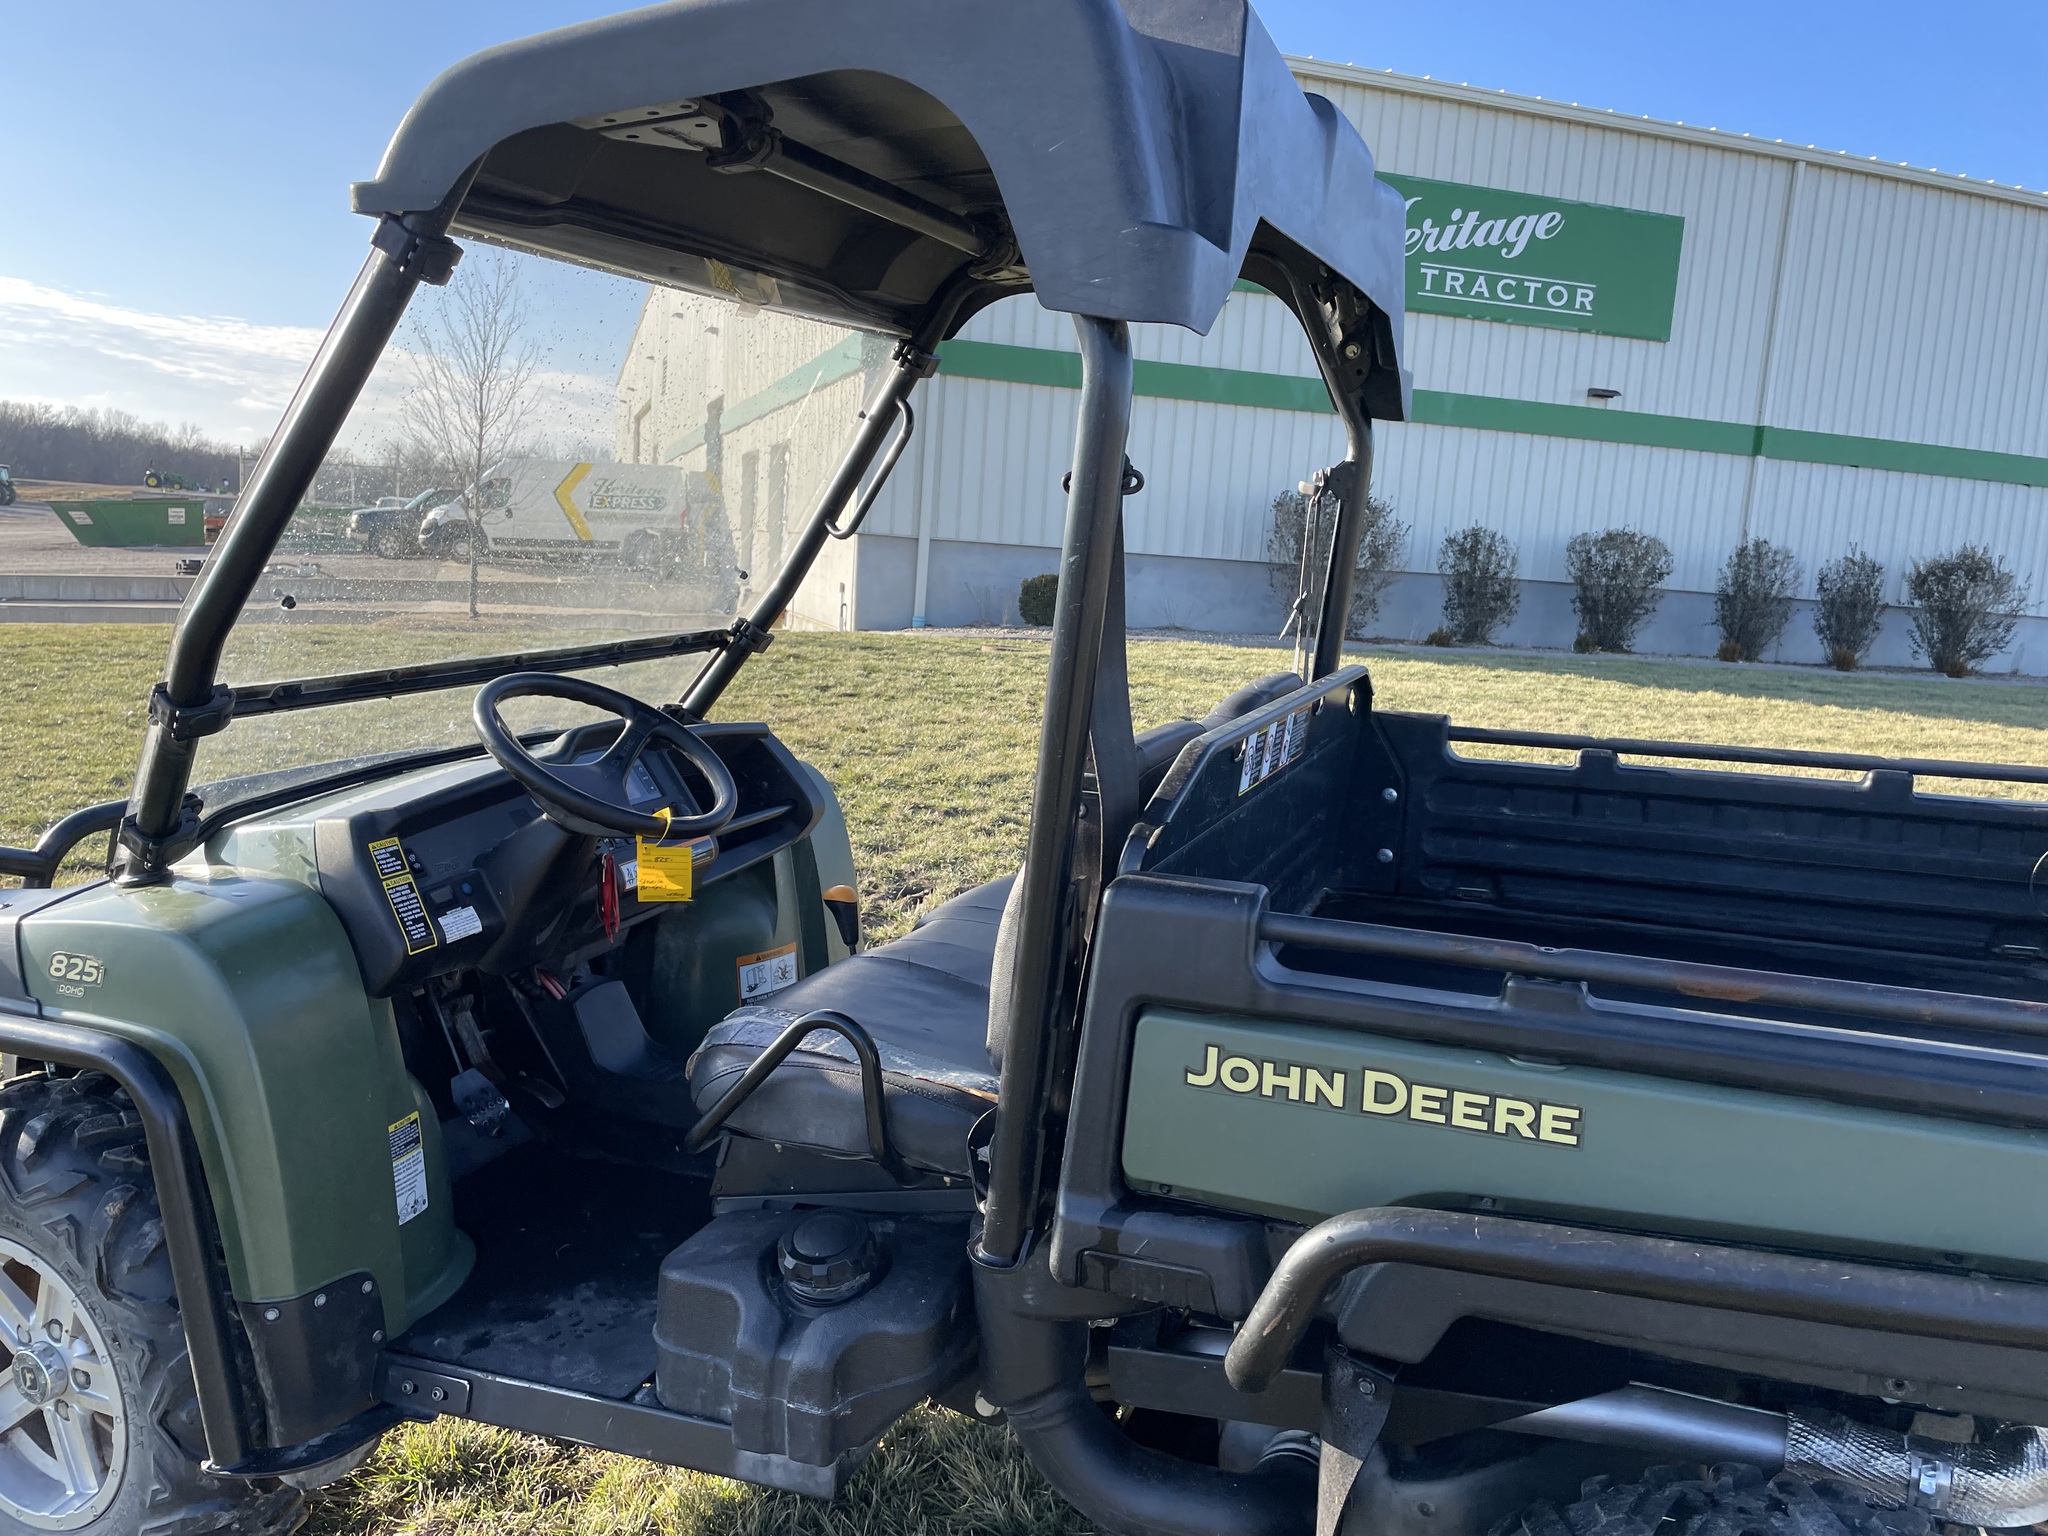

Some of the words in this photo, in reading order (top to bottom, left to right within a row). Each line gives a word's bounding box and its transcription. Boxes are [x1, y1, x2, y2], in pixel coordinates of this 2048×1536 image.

[1404, 197, 1565, 259] eritage
[1420, 267, 1595, 311] TRACTOR
[592, 495, 657, 511] EXPRESS
[390, 876, 411, 886] CAUTION
[49, 954, 104, 984] 825i
[58, 984, 84, 996] DOHC
[1186, 1043, 1346, 1109] JOHN
[1361, 1067, 1581, 1146] DEERE
